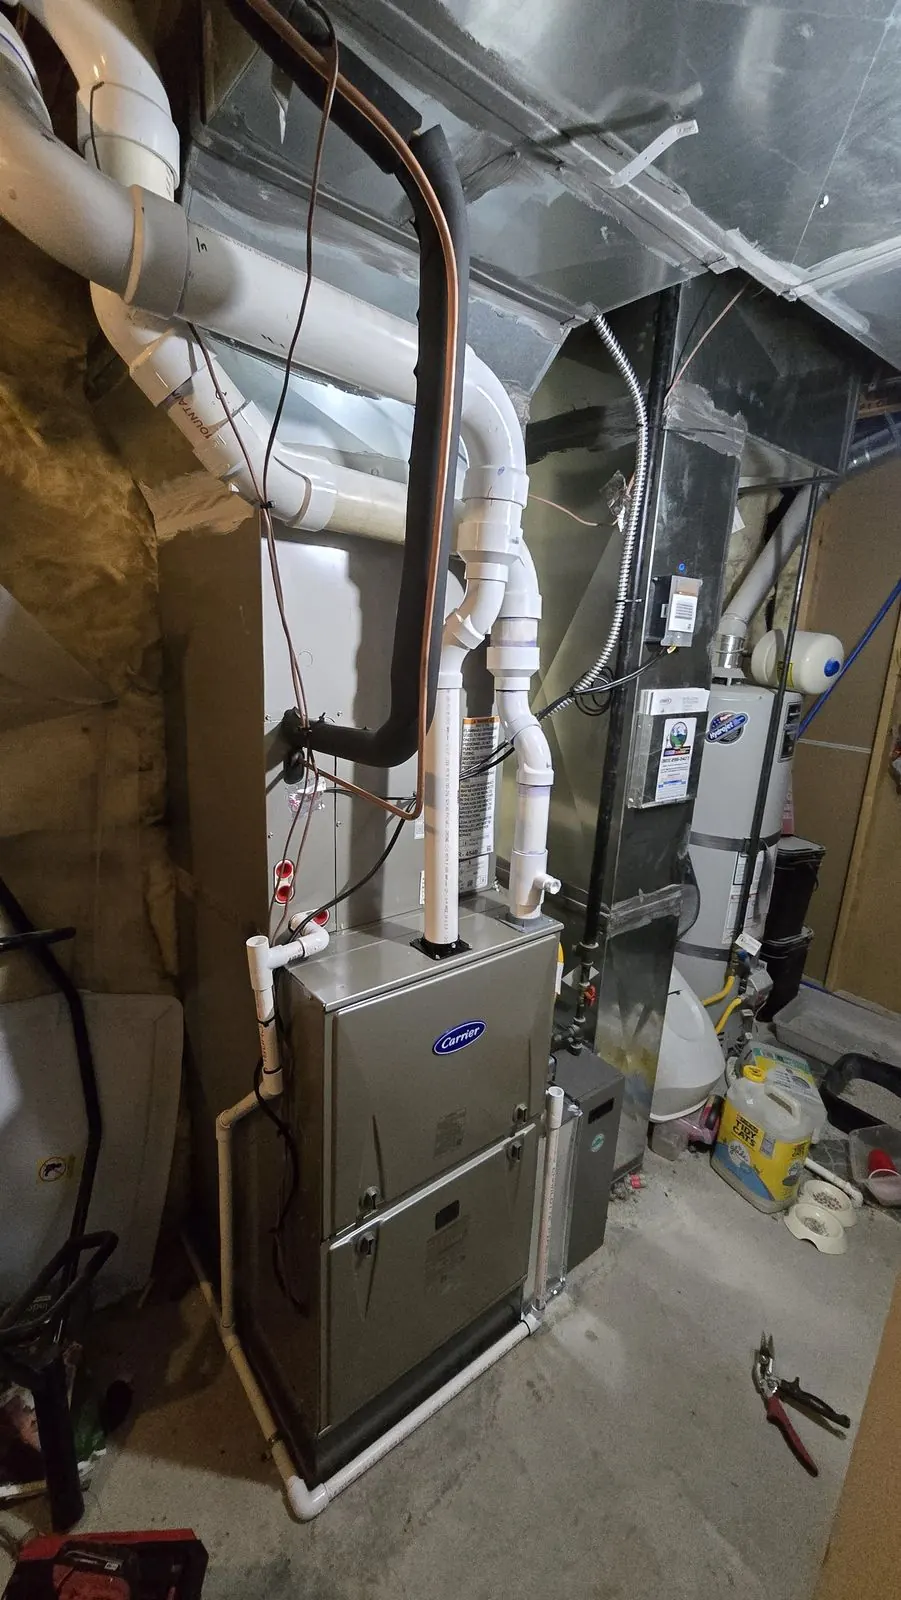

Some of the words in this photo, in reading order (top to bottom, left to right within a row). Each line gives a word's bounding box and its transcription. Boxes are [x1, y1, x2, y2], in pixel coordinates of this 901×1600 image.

[441, 1026, 480, 1049] Carrier
[733, 1126, 755, 1147] CATS
[736, 1119, 756, 1139] TIDY
